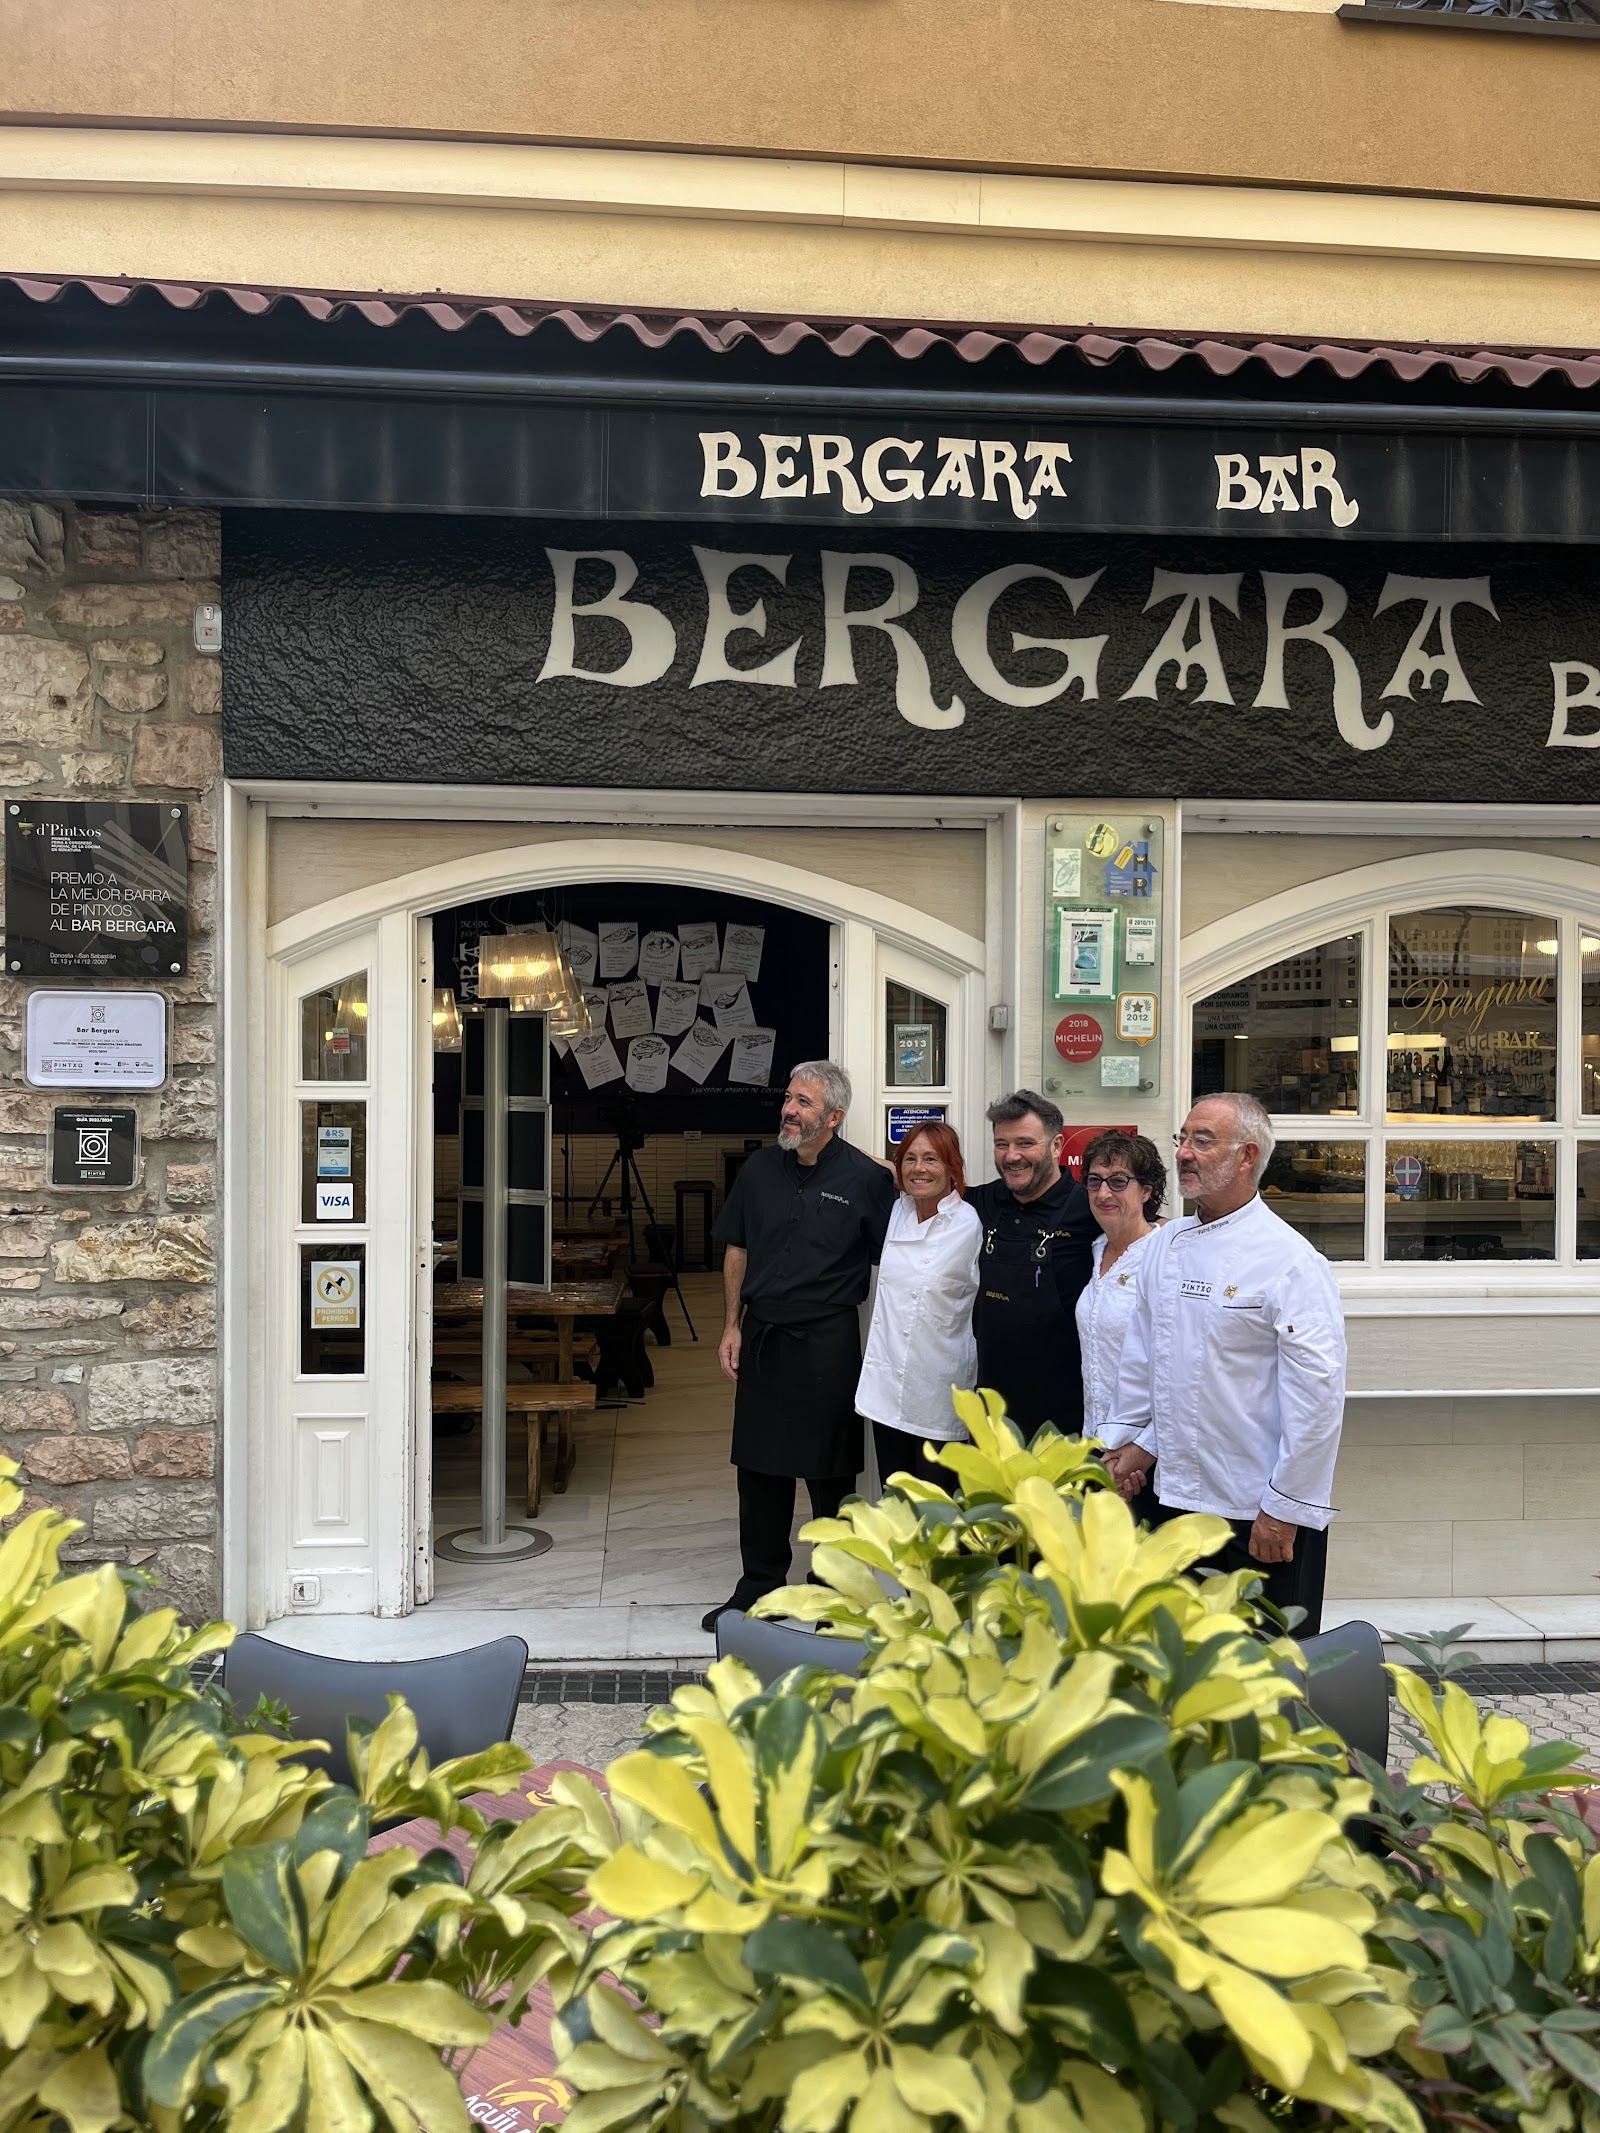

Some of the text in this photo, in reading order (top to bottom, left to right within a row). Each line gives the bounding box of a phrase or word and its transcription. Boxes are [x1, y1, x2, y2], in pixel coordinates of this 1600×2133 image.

[699, 431, 1359, 527] BERGARA BAR
[535, 544, 1501, 751] BERGARA
[50, 871, 118, 885] PREMIO A
[50, 887, 171, 901] LA MEJOR BARRA
[50, 903, 133, 917] DE PINTXOS
[50, 919, 176, 933] AL BAR BERGARA
[1393, 975, 1550, 1034] Bergara
[1068, 1020, 1089, 1028] 2018
[899, 1040, 927, 1048] 2013
[1055, 1034, 1102, 1043] MICHELIN
[1497, 1030, 1540, 1049] BAR
[332, 1129, 344, 1137] RS
[320, 1196, 350, 1206] VISA
[1181, 1283, 1212, 1293] PINTXO
[505, 2107, 521, 2119] EL
